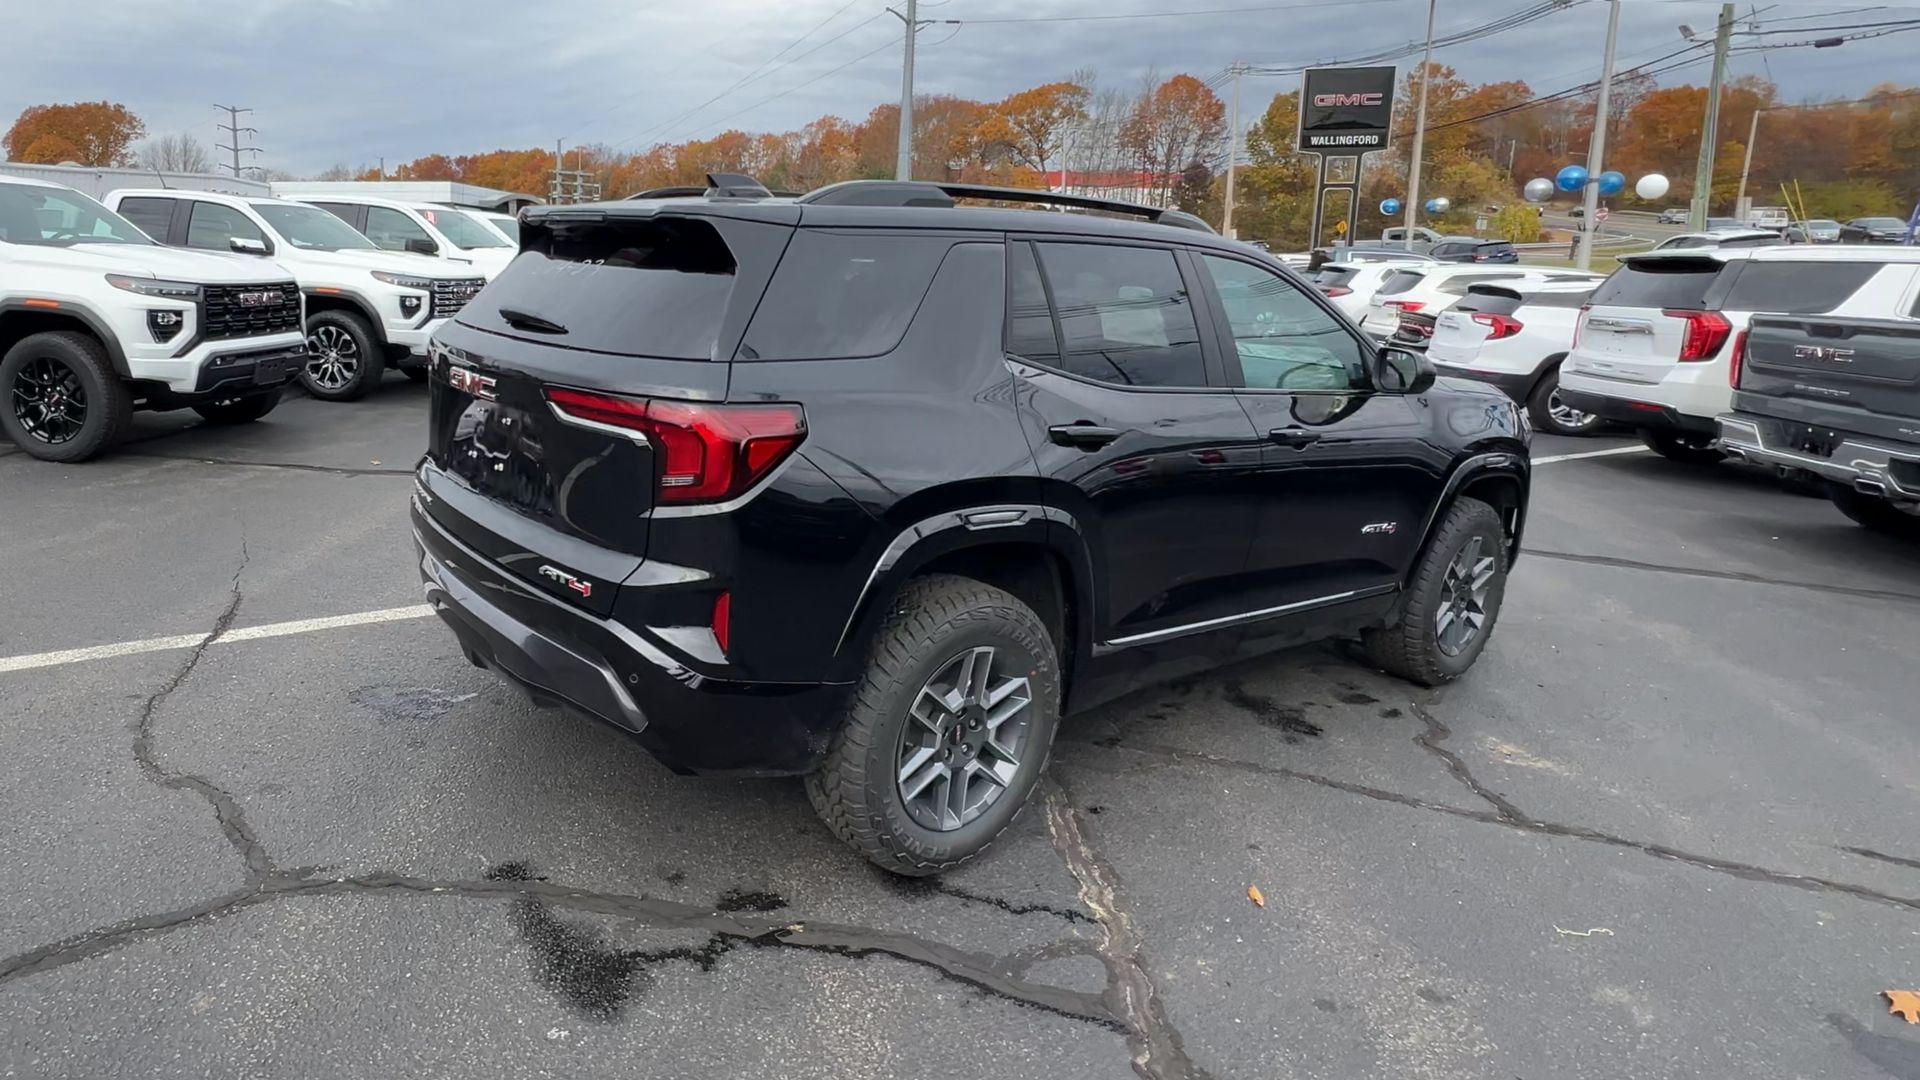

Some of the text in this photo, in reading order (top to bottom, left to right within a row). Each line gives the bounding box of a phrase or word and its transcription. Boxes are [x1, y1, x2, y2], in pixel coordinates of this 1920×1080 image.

[1314, 93, 1383, 107] GMC
[1310, 135, 1379, 146] WALLINGFORD
[240, 291, 284, 308] GMC
[1794, 344, 1855, 363] GMC
[449, 366, 498, 402] GMC
[538, 564, 592, 598] AT4
